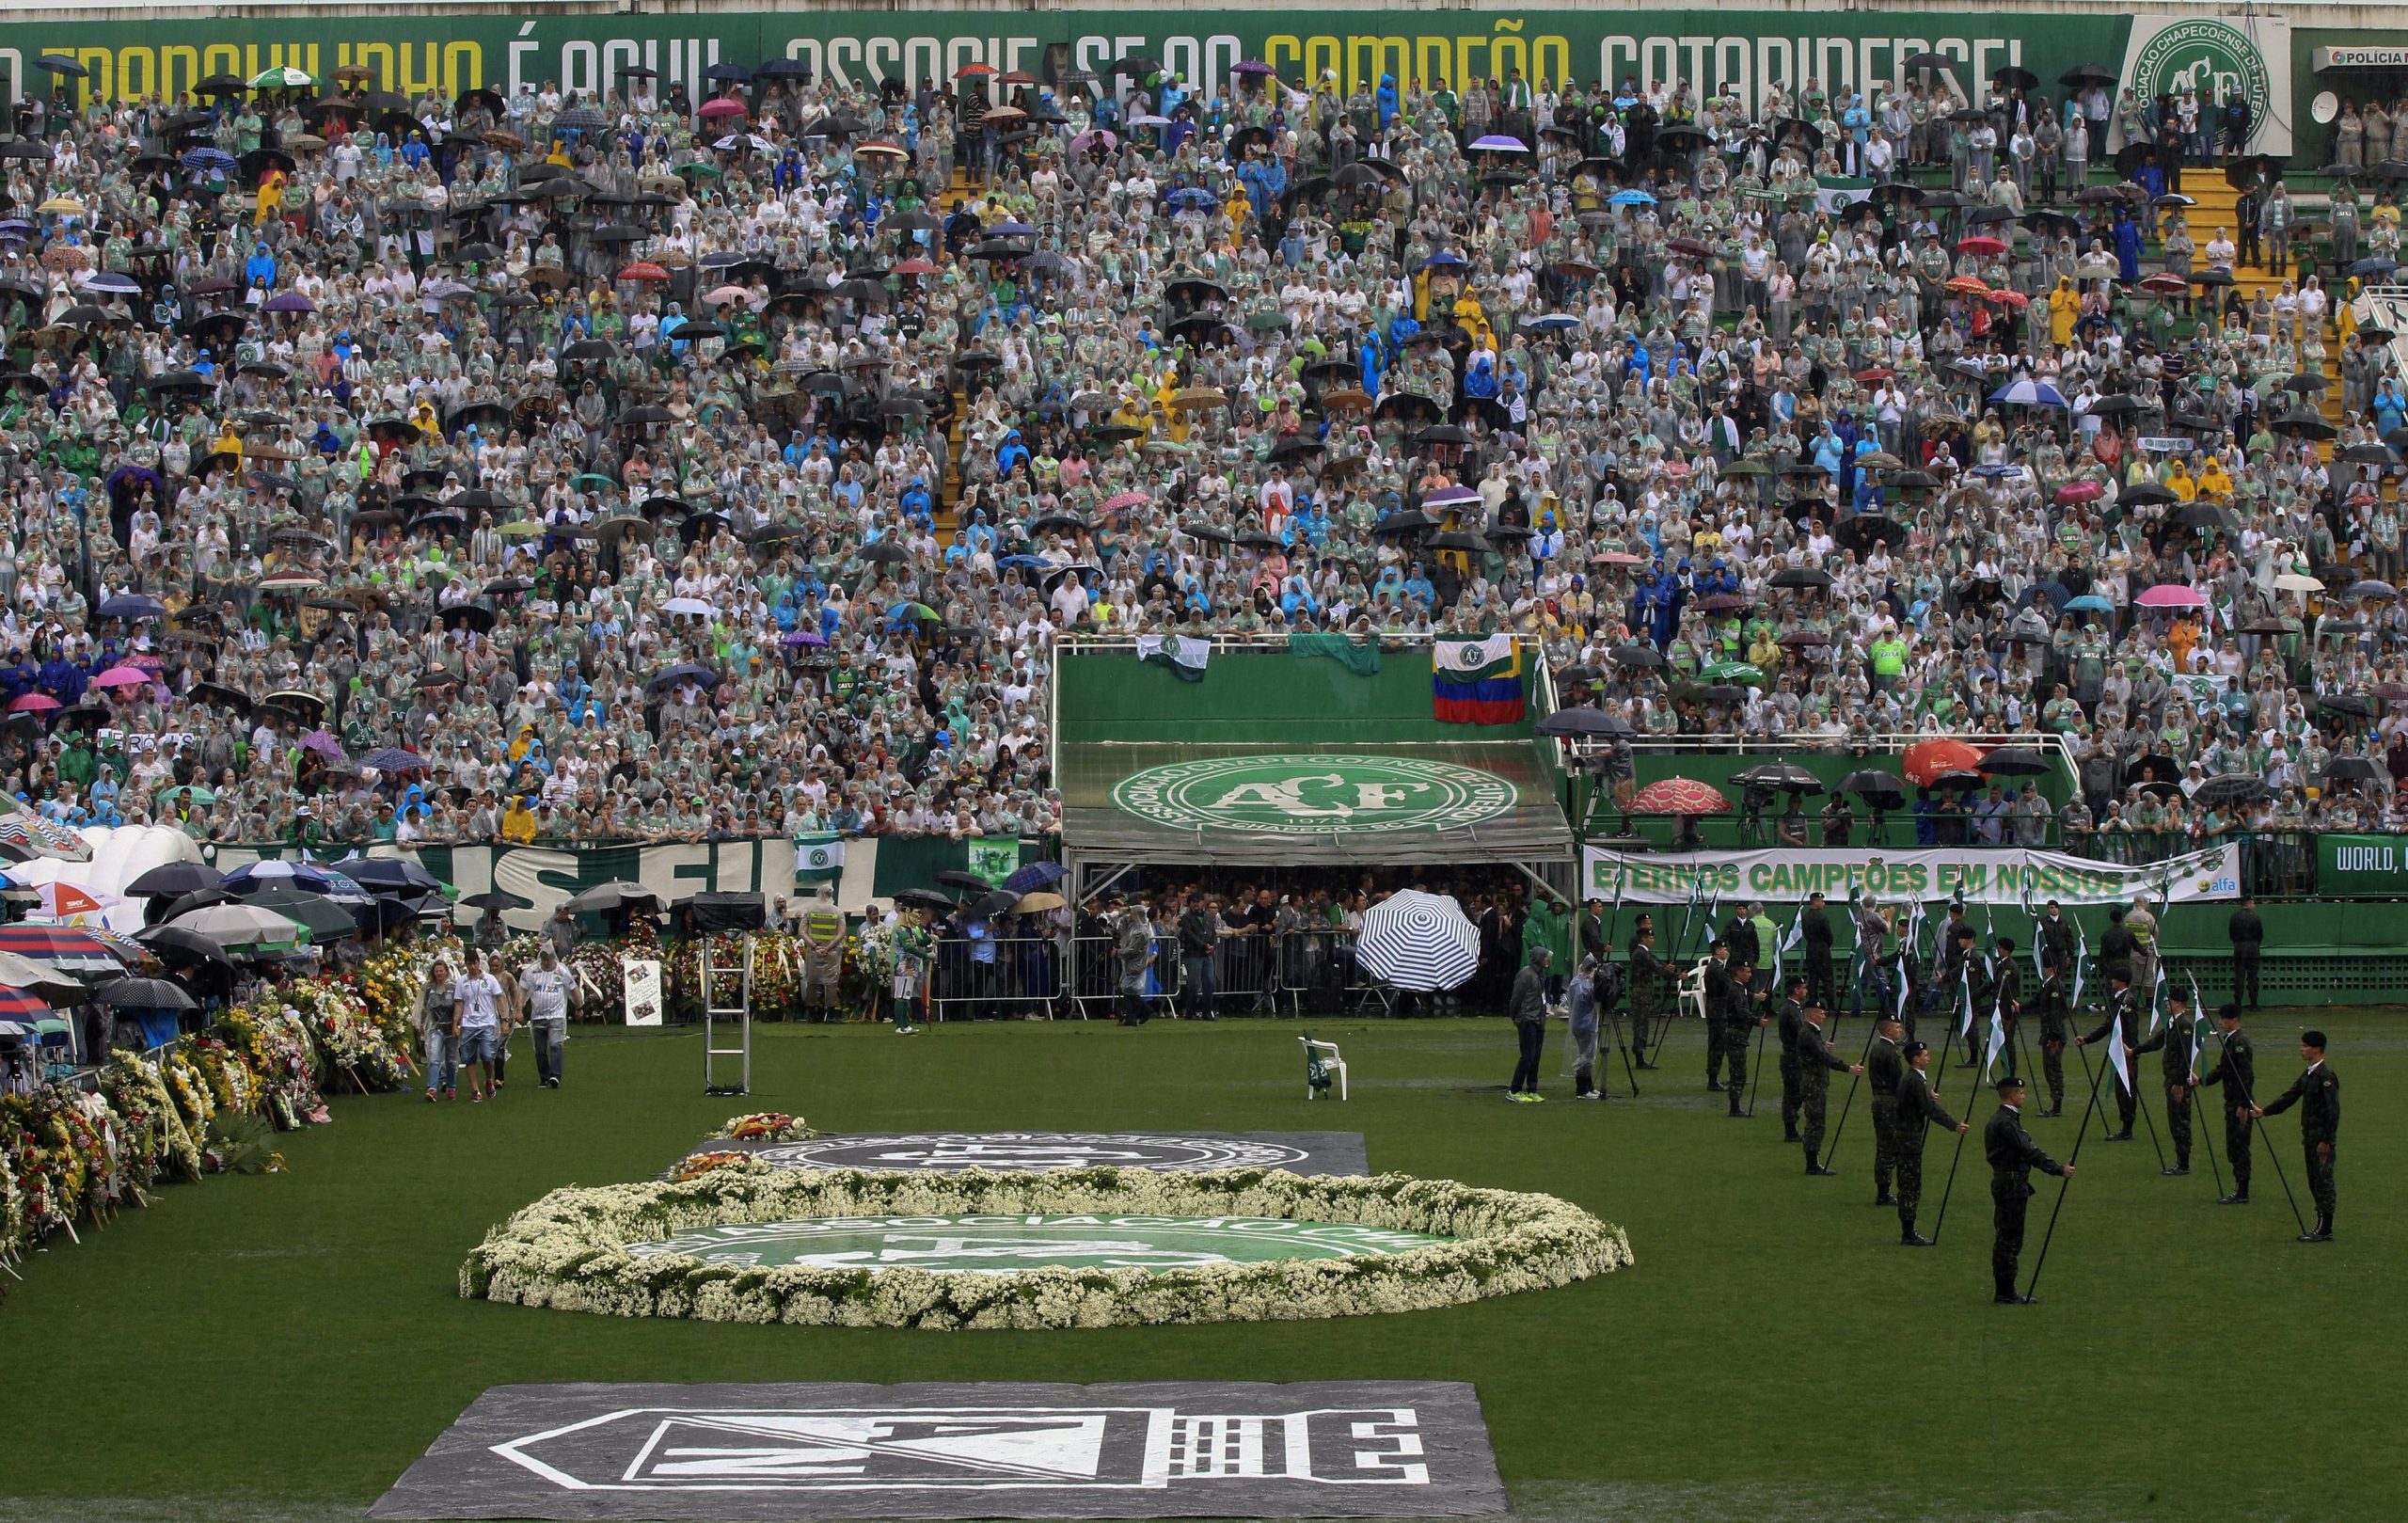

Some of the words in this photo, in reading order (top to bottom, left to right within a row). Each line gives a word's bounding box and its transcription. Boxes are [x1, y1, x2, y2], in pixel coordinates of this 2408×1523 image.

[2156, 25, 2251, 57] CHAPECOENSE
[1264, 19, 1569, 120] CAMPEÃO
[2346, 51, 2402, 64] POLÍCIA
[1185, 755, 1457, 775] CHAPECOENSE
[2337, 847, 2399, 874] WORLD,
[1592, 860, 1740, 893] ETERNOS
[1748, 857, 1928, 894] CAMPEÕES
[1937, 864, 1988, 894] EM
[1996, 864, 2123, 895] NOSSOS
[2211, 878, 2236, 892] alfa
